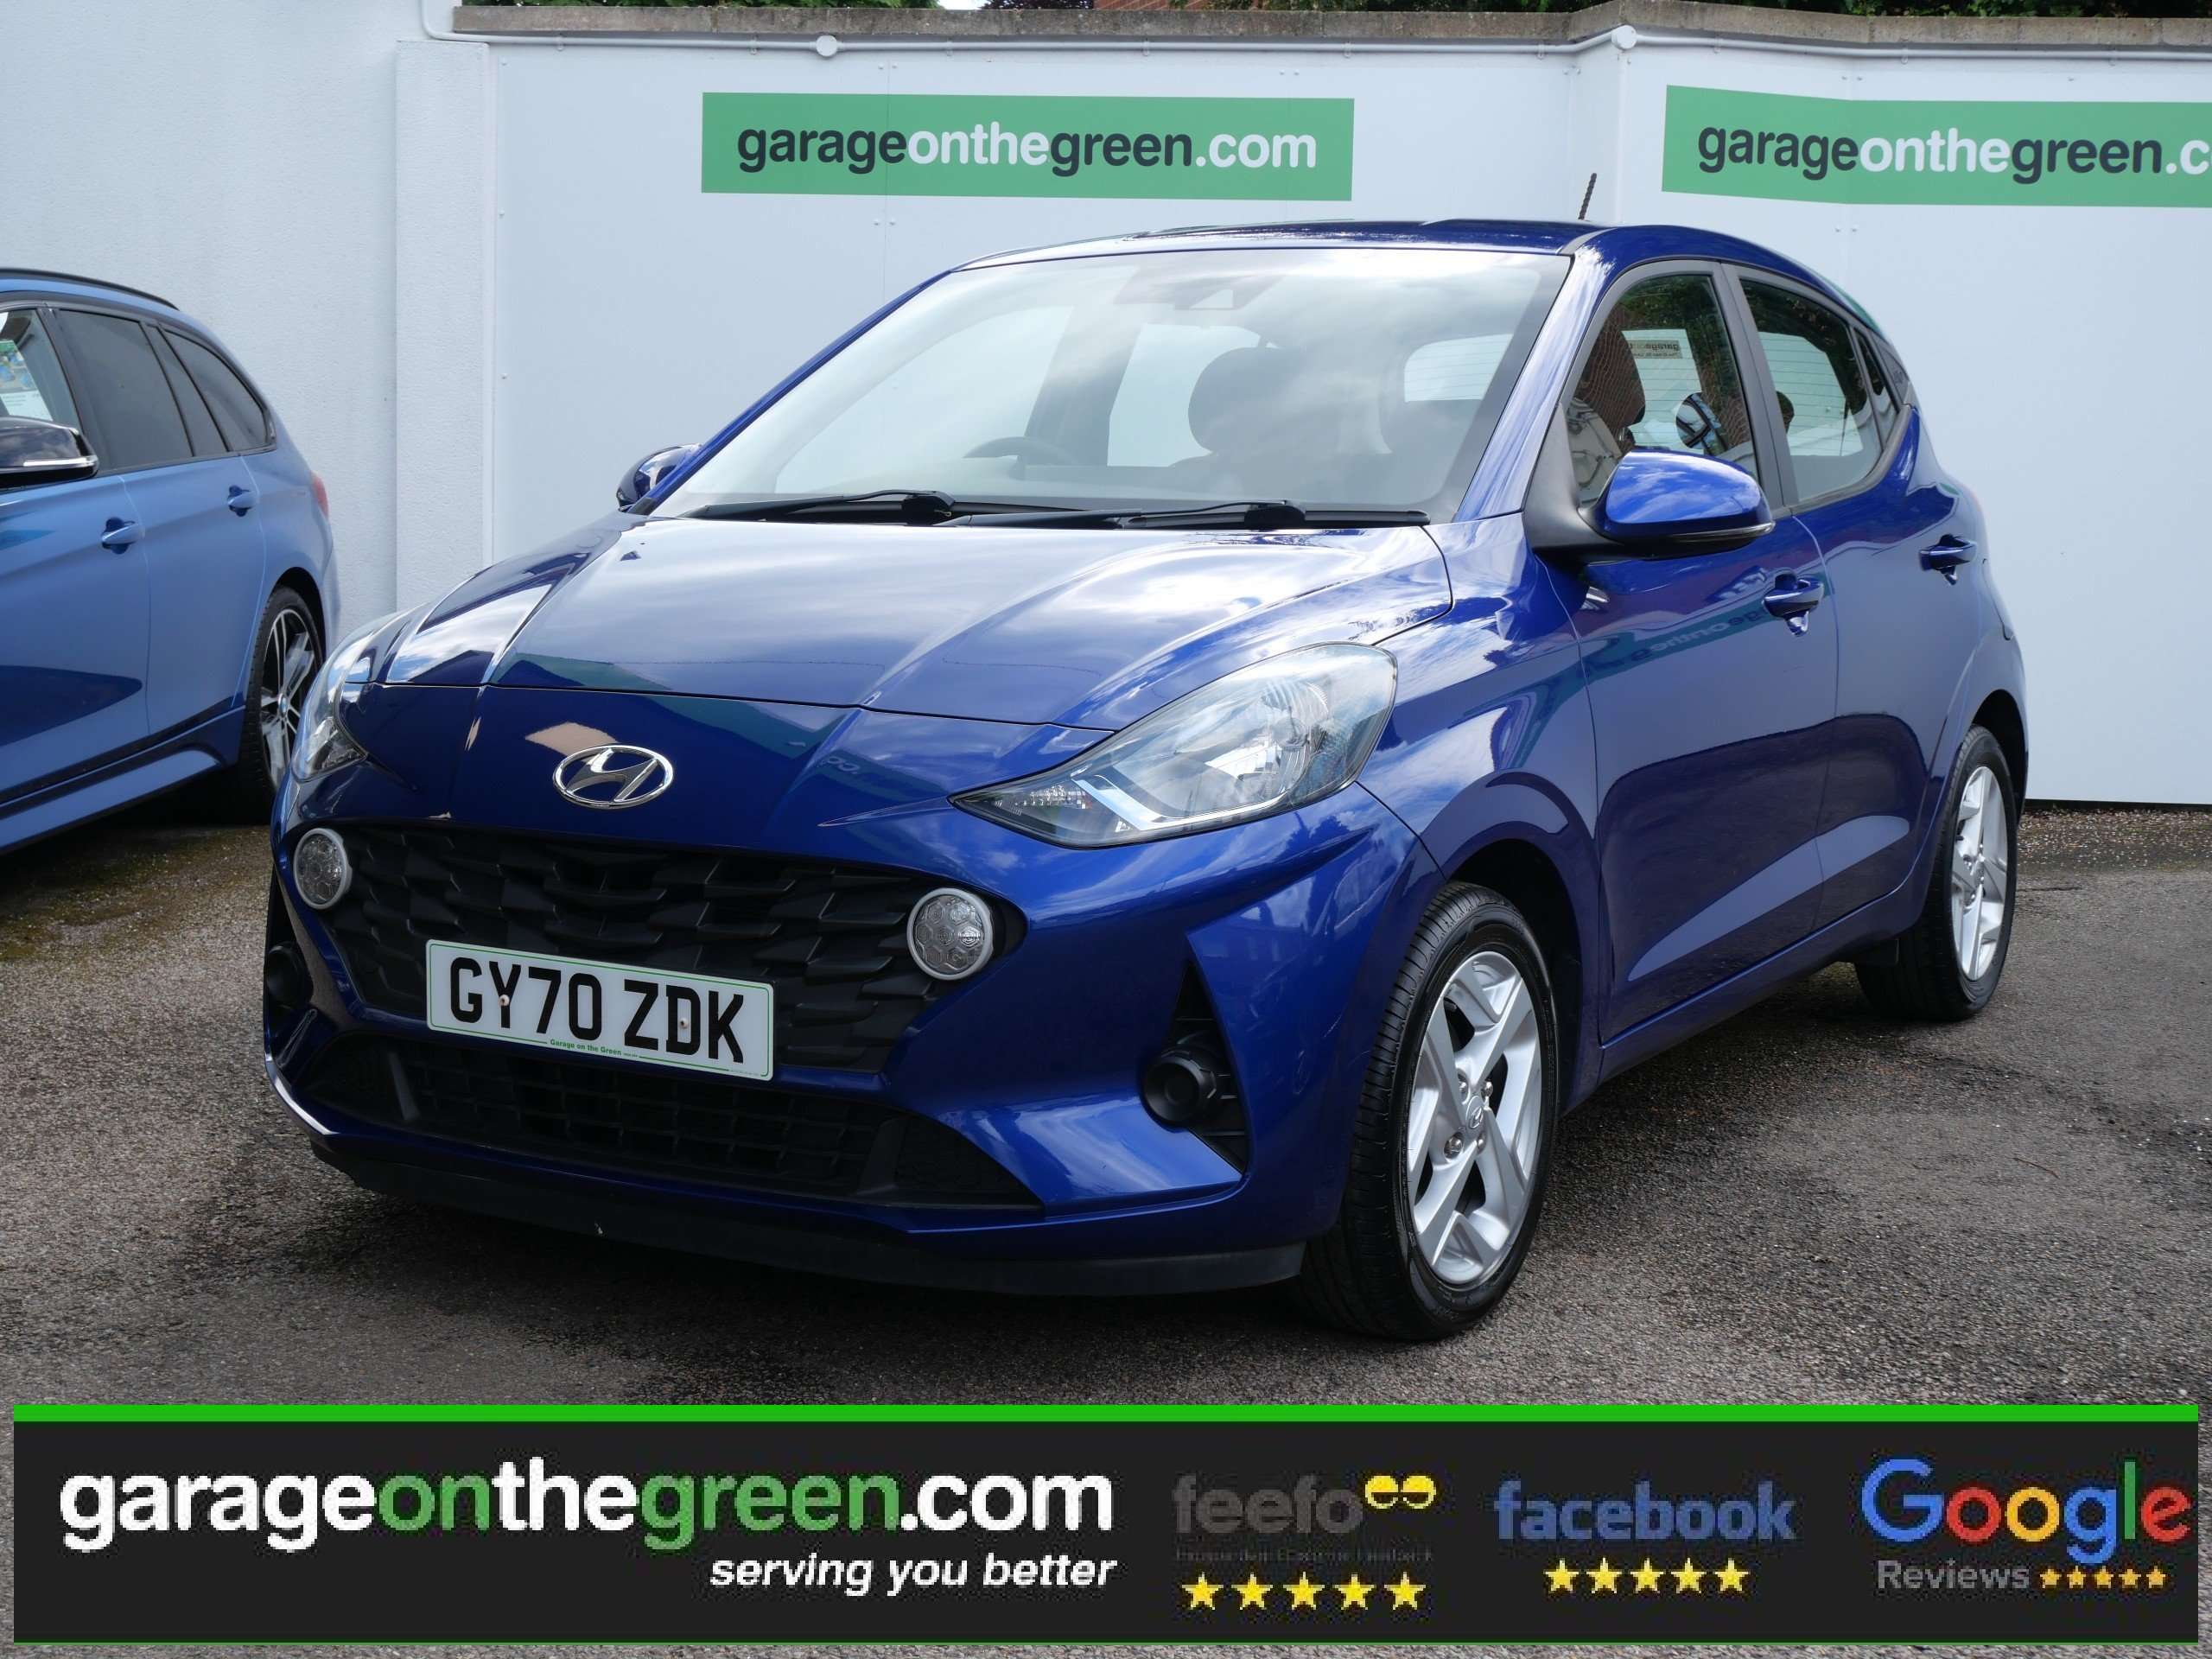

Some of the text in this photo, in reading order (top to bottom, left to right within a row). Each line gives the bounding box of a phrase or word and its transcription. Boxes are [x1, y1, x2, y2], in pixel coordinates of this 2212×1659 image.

[738, 121, 1317, 177] garageonthegreen.com
[1698, 127, 2212, 184] garageonthegreen.c
[449, 957, 744, 1064] GY70 ZDK
[550, 1039, 575, 1050] Garage
[588, 1043, 599, 1052] the
[601, 1044, 622, 1056] Green
